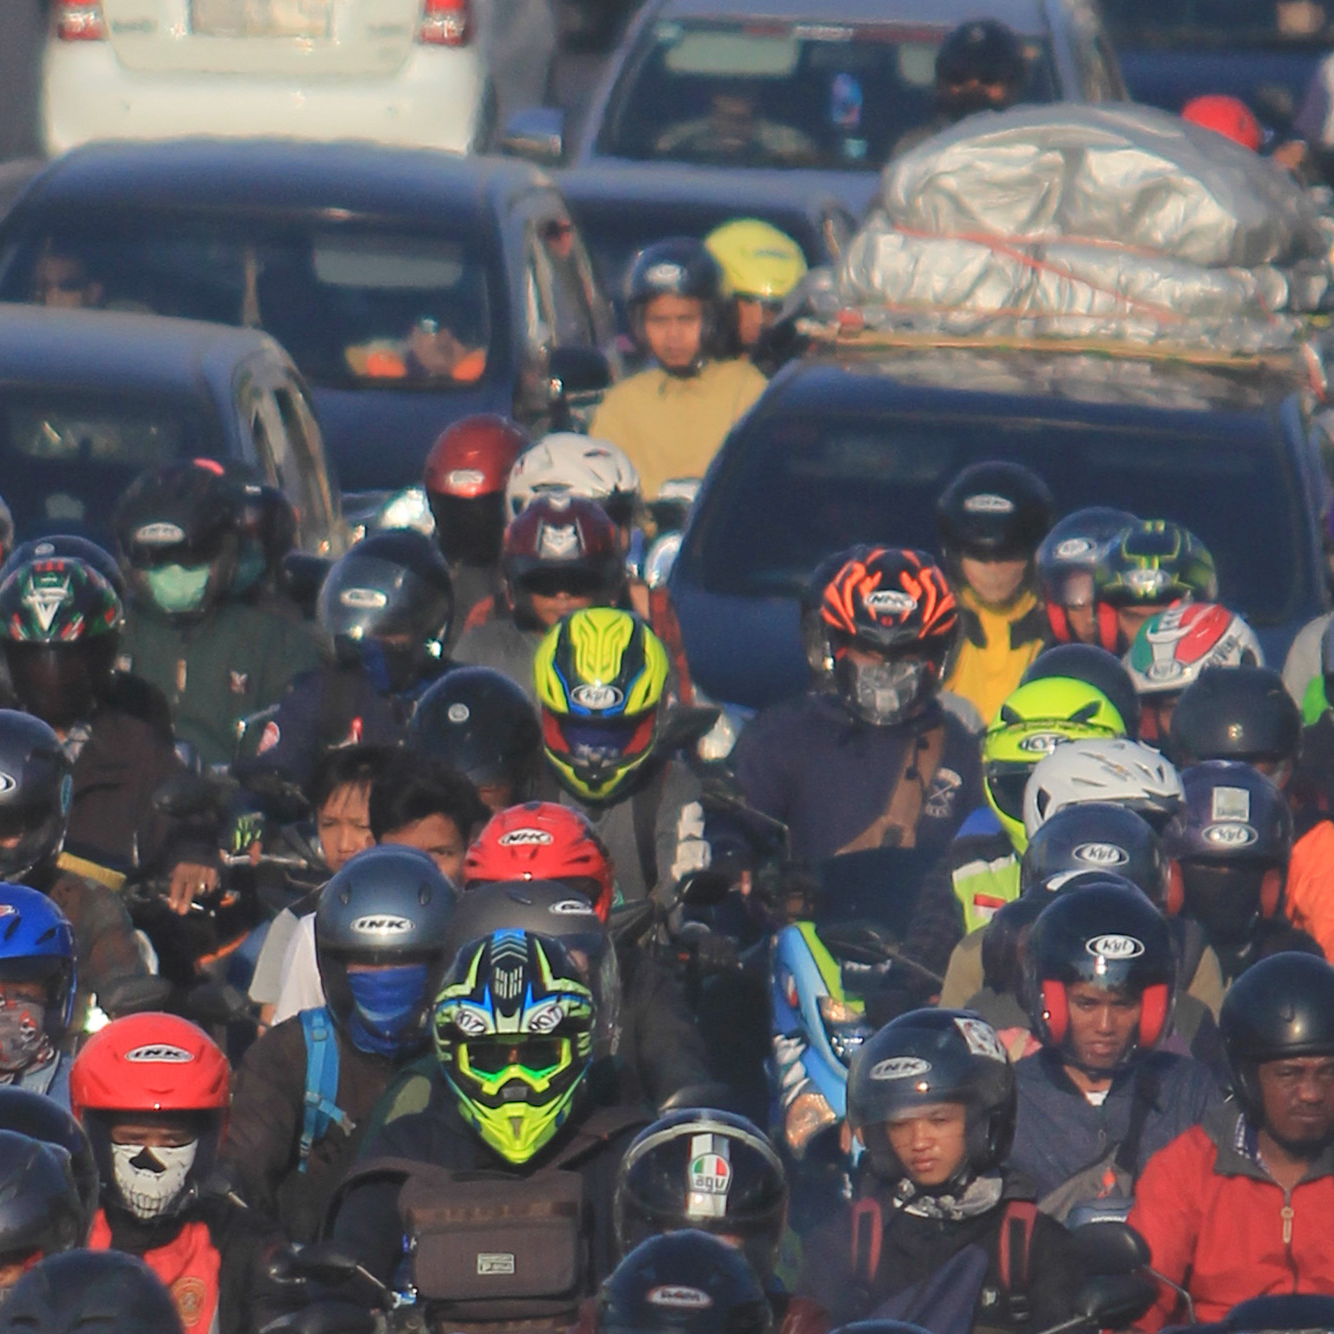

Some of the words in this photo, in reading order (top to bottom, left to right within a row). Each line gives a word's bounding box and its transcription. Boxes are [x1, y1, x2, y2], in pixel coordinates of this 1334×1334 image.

[357, 918, 407, 932] INK
[133, 1048, 182, 1060] INK
[875, 1061, 922, 1075] INK
